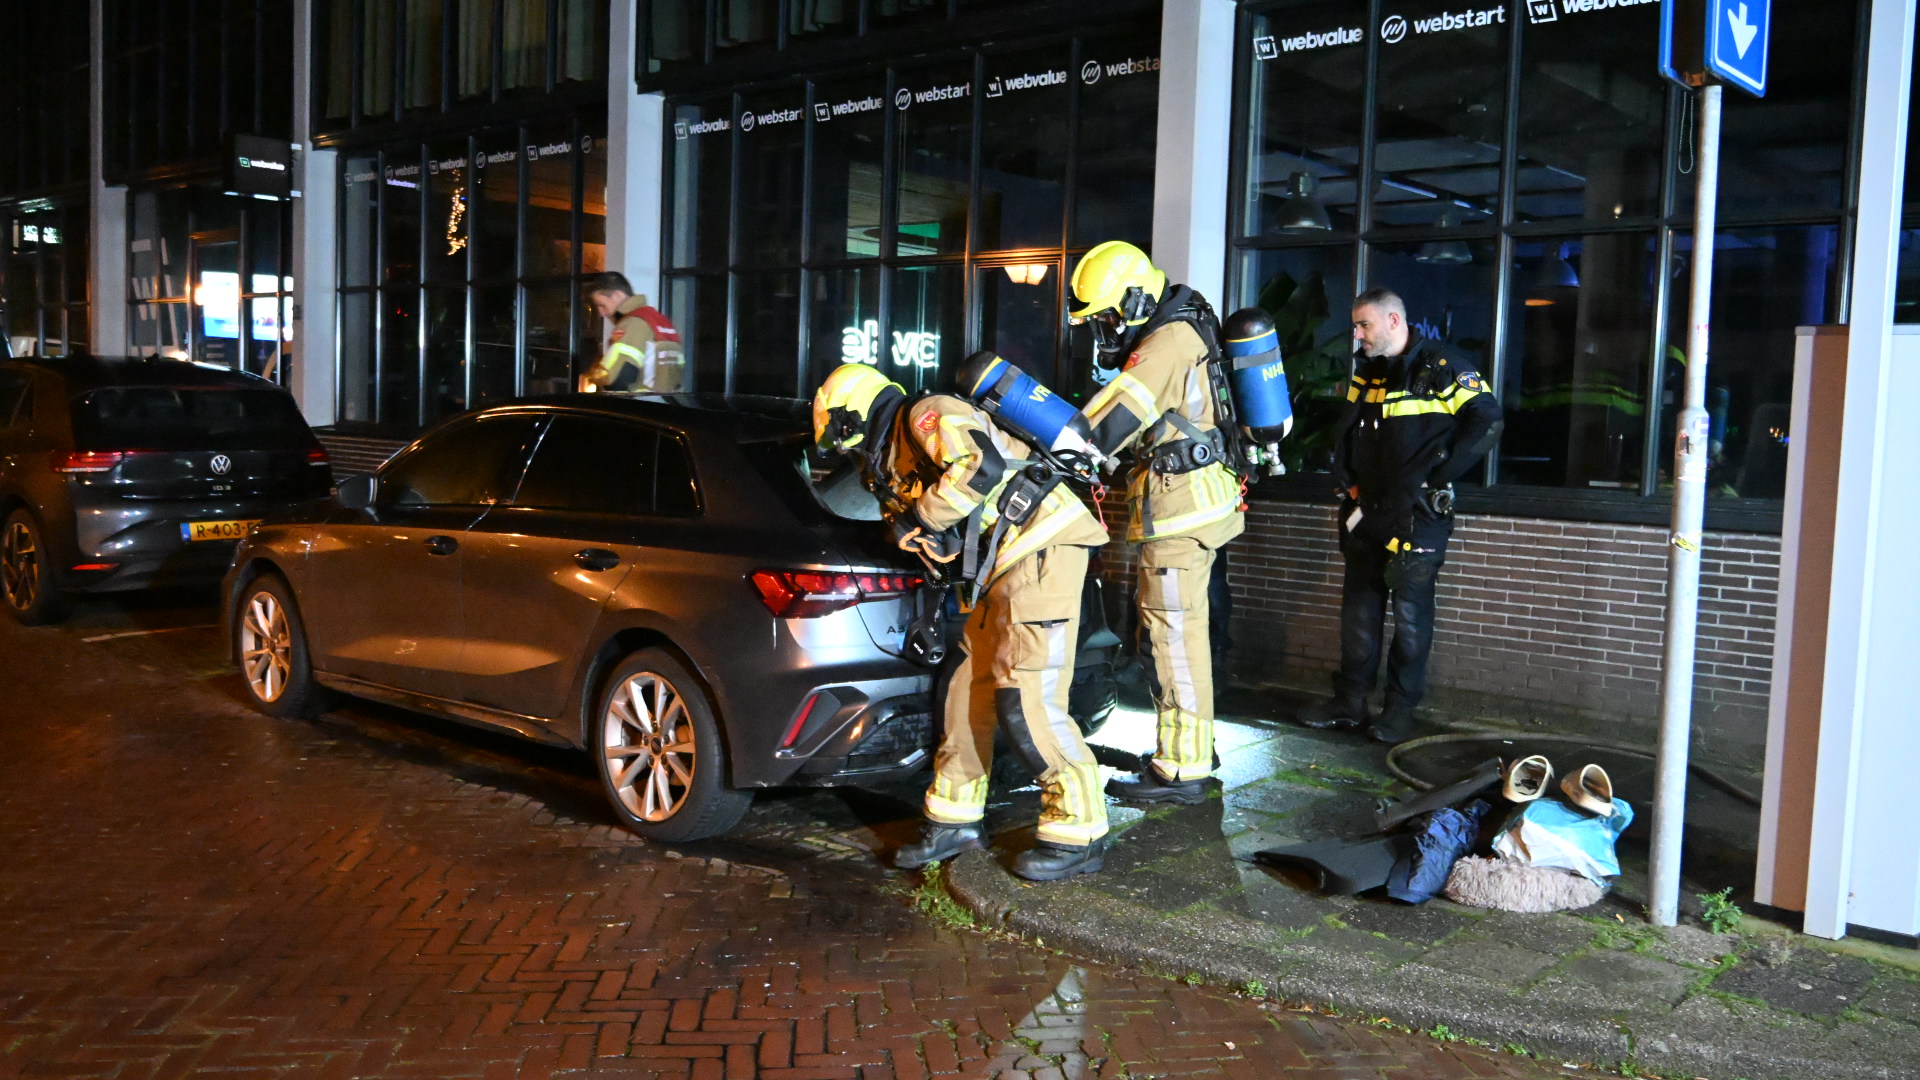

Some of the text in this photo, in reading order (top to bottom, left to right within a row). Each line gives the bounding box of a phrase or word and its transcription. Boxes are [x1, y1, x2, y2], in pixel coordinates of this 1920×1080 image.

[1414, 7, 1506, 35] webstart
[1281, 24, 1364, 52] webvalue
[1005, 69, 1067, 91] webvalue
[915, 82, 971, 104] webstart
[832, 96, 883, 116] webvalue
